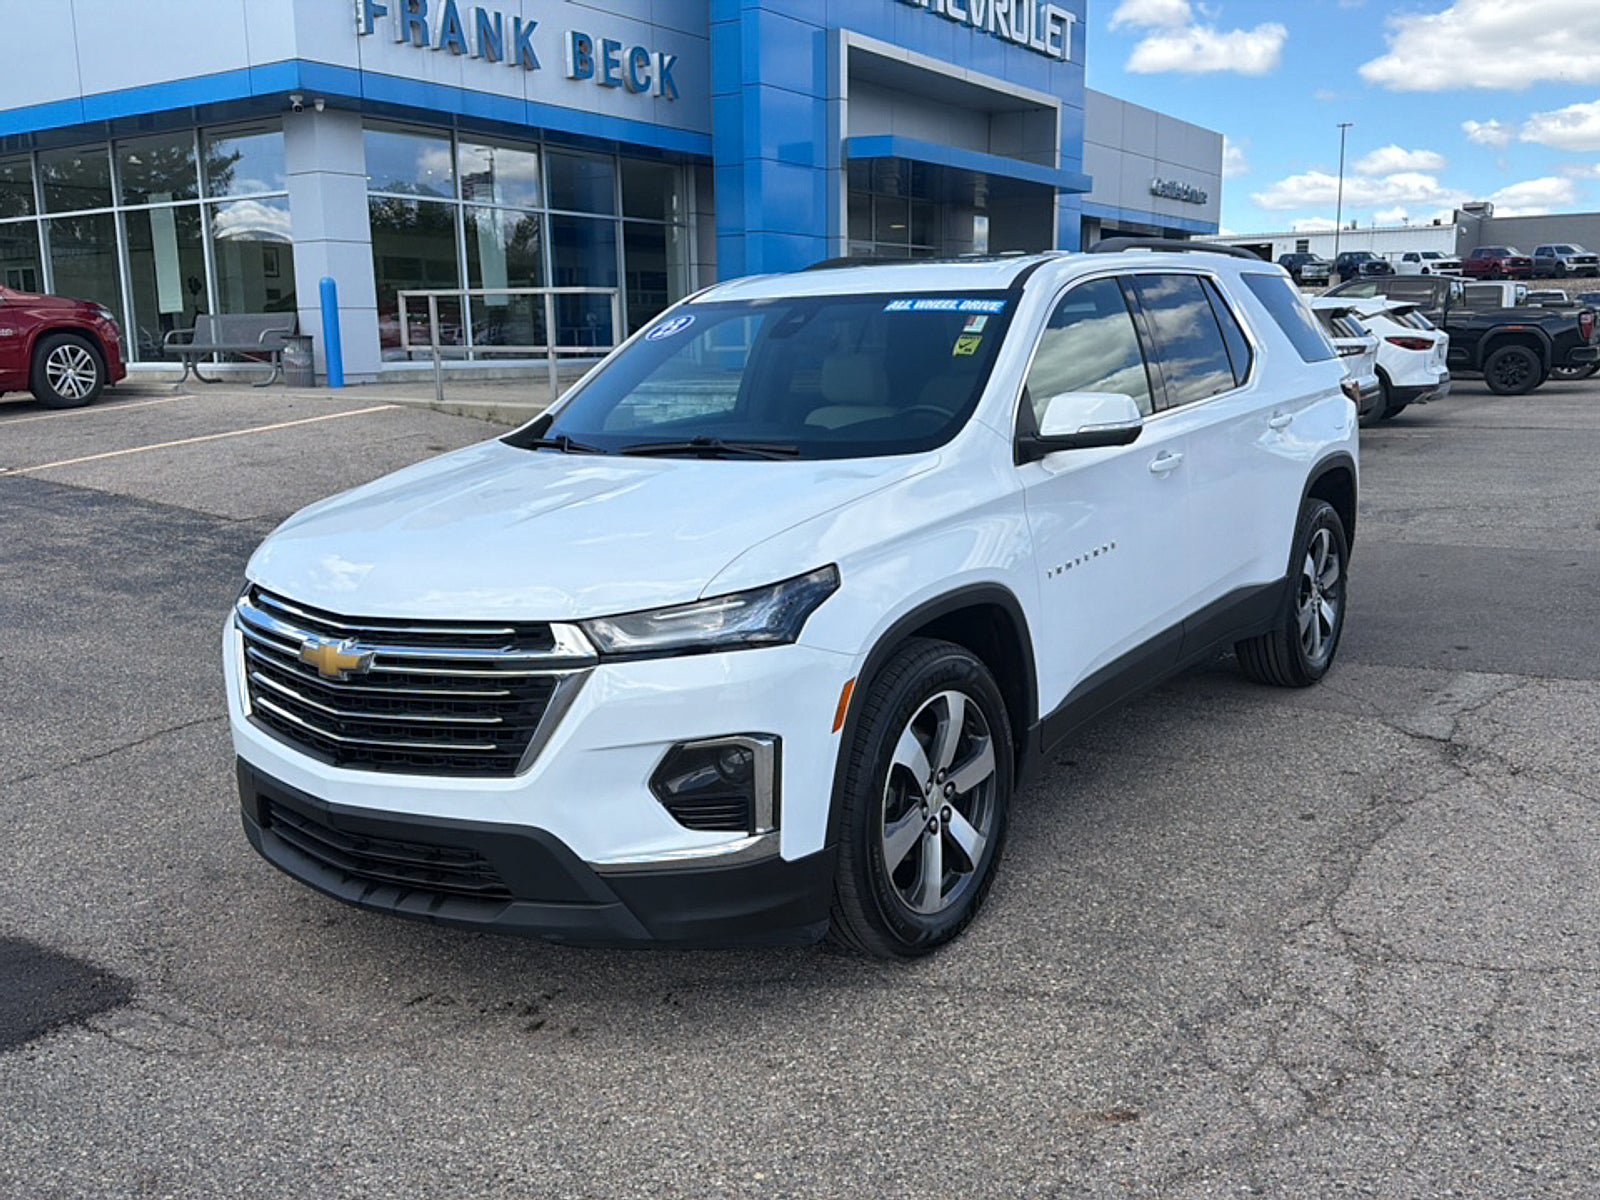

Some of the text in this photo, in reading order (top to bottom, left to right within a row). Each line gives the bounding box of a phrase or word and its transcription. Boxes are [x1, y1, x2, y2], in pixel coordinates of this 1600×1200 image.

[356, 0, 678, 100] FRANK BECK
[913, 0, 1076, 61] VROLET
[883, 300, 1005, 313] ALL WHEEL DRIVE
